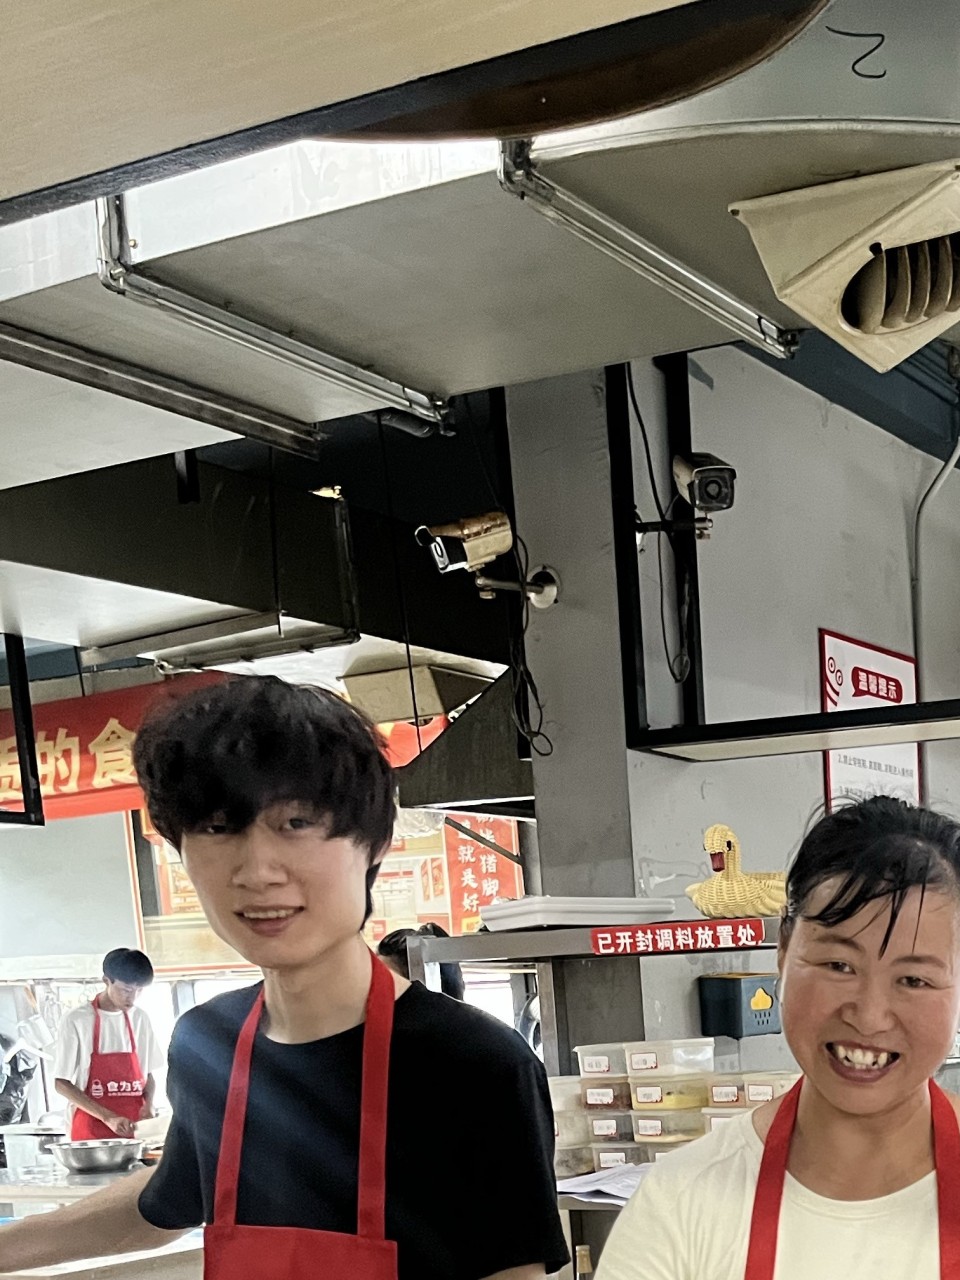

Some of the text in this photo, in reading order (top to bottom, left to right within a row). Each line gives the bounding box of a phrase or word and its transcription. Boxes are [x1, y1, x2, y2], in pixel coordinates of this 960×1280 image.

[858, 671, 897, 699] 温馨提示
[597, 925, 757, 953] 已开封调料放置处
